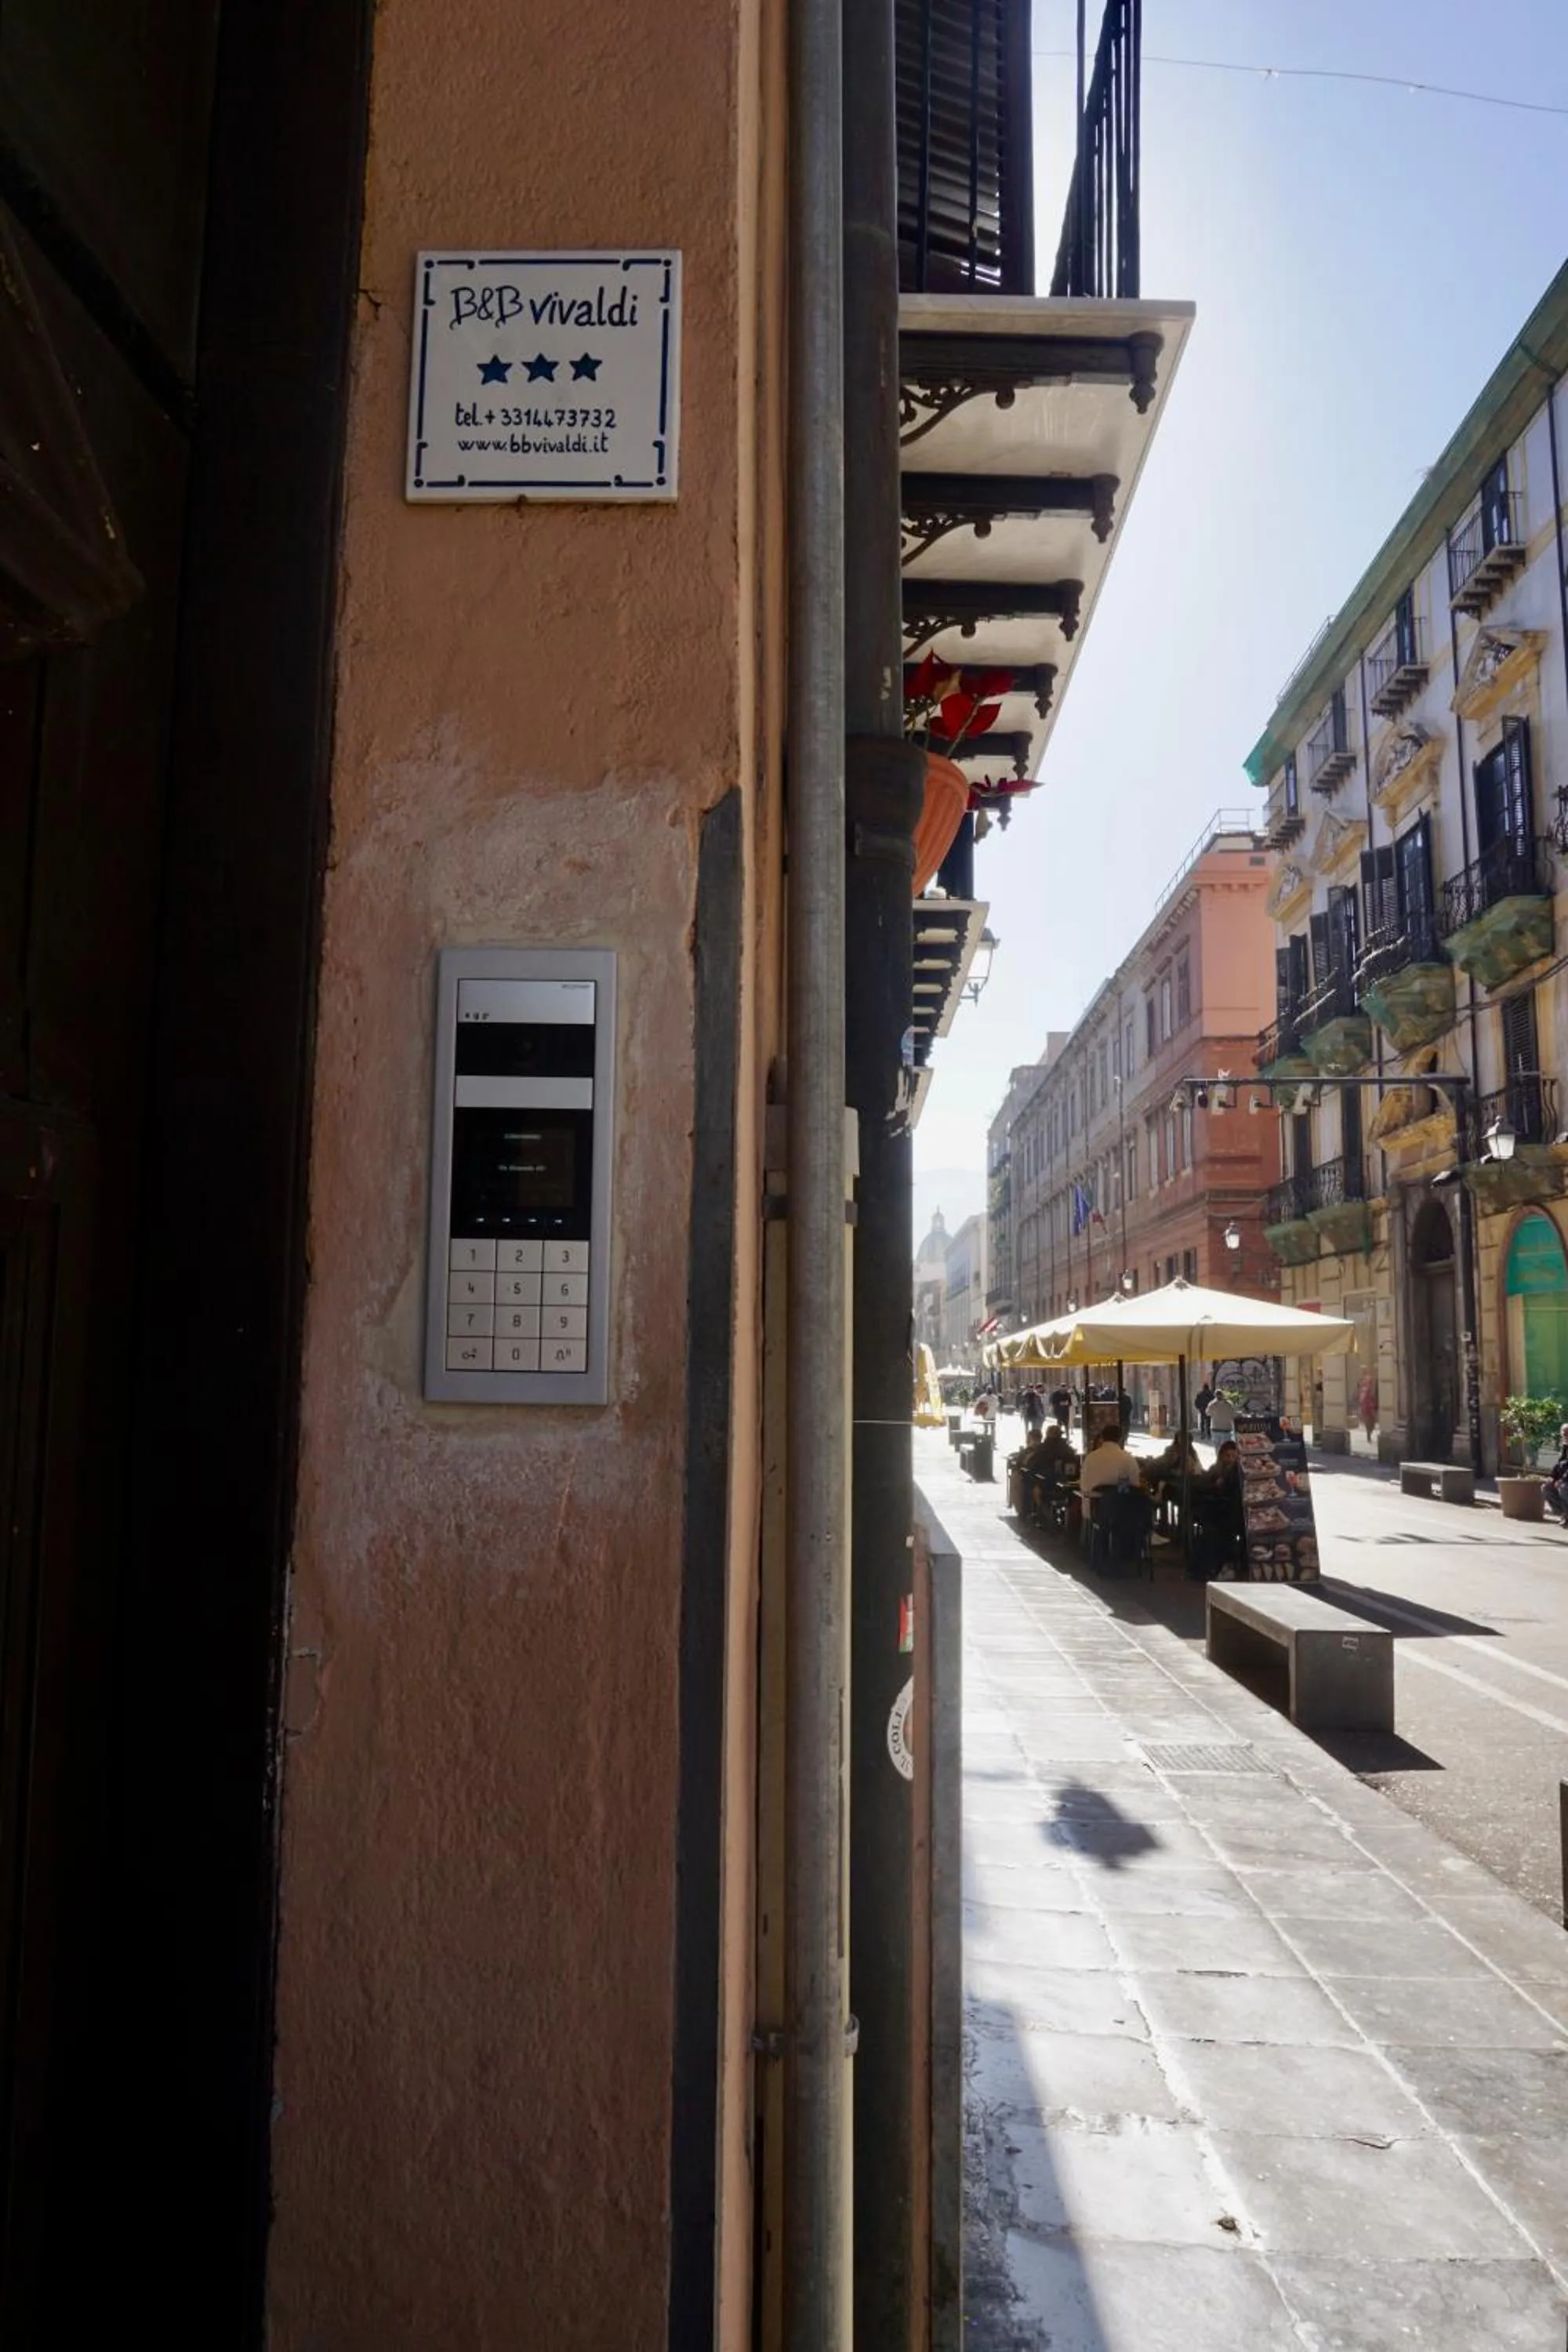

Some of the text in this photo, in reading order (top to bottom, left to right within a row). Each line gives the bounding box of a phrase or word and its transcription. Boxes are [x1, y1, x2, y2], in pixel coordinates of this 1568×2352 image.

[449, 285, 523, 330] B&B
[458, 432, 608, 453] www.bbvivaldi.it
[514, 1249, 523, 1262] 2
[561, 1250, 570, 1263] 3
[467, 1282, 568, 1296] 4 5 6
[466, 1313, 568, 1328] 7 8 9
[512, 1348, 519, 1360] 0
